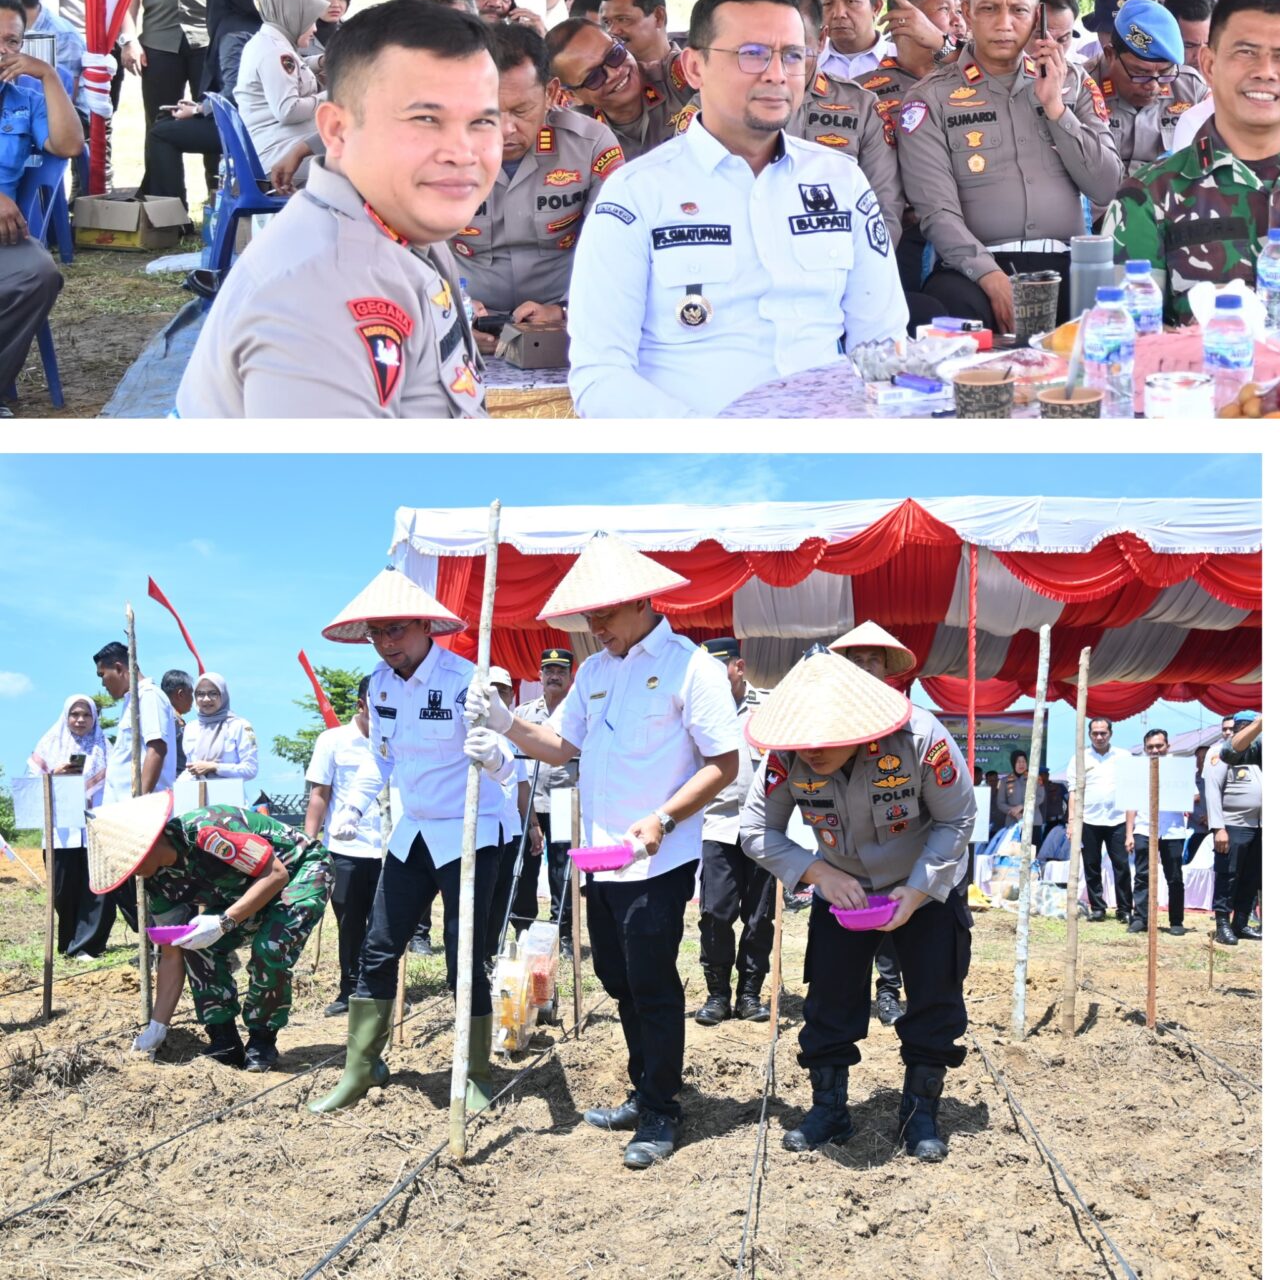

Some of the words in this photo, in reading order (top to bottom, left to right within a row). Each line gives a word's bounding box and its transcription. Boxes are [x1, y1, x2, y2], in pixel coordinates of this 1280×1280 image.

[808, 113, 858, 130] POLRI
[947, 111, 997, 128] SUMARDI
[594, 147, 620, 172] POLRES
[537, 190, 590, 210] POLRI
[796, 216, 849, 230] BUPATI
[356, 300, 410, 330] GEGANA
[1014, 303, 1056, 318] COFFEE
[927, 740, 946, 762] POLRES
[872, 787, 916, 805] POLRI
